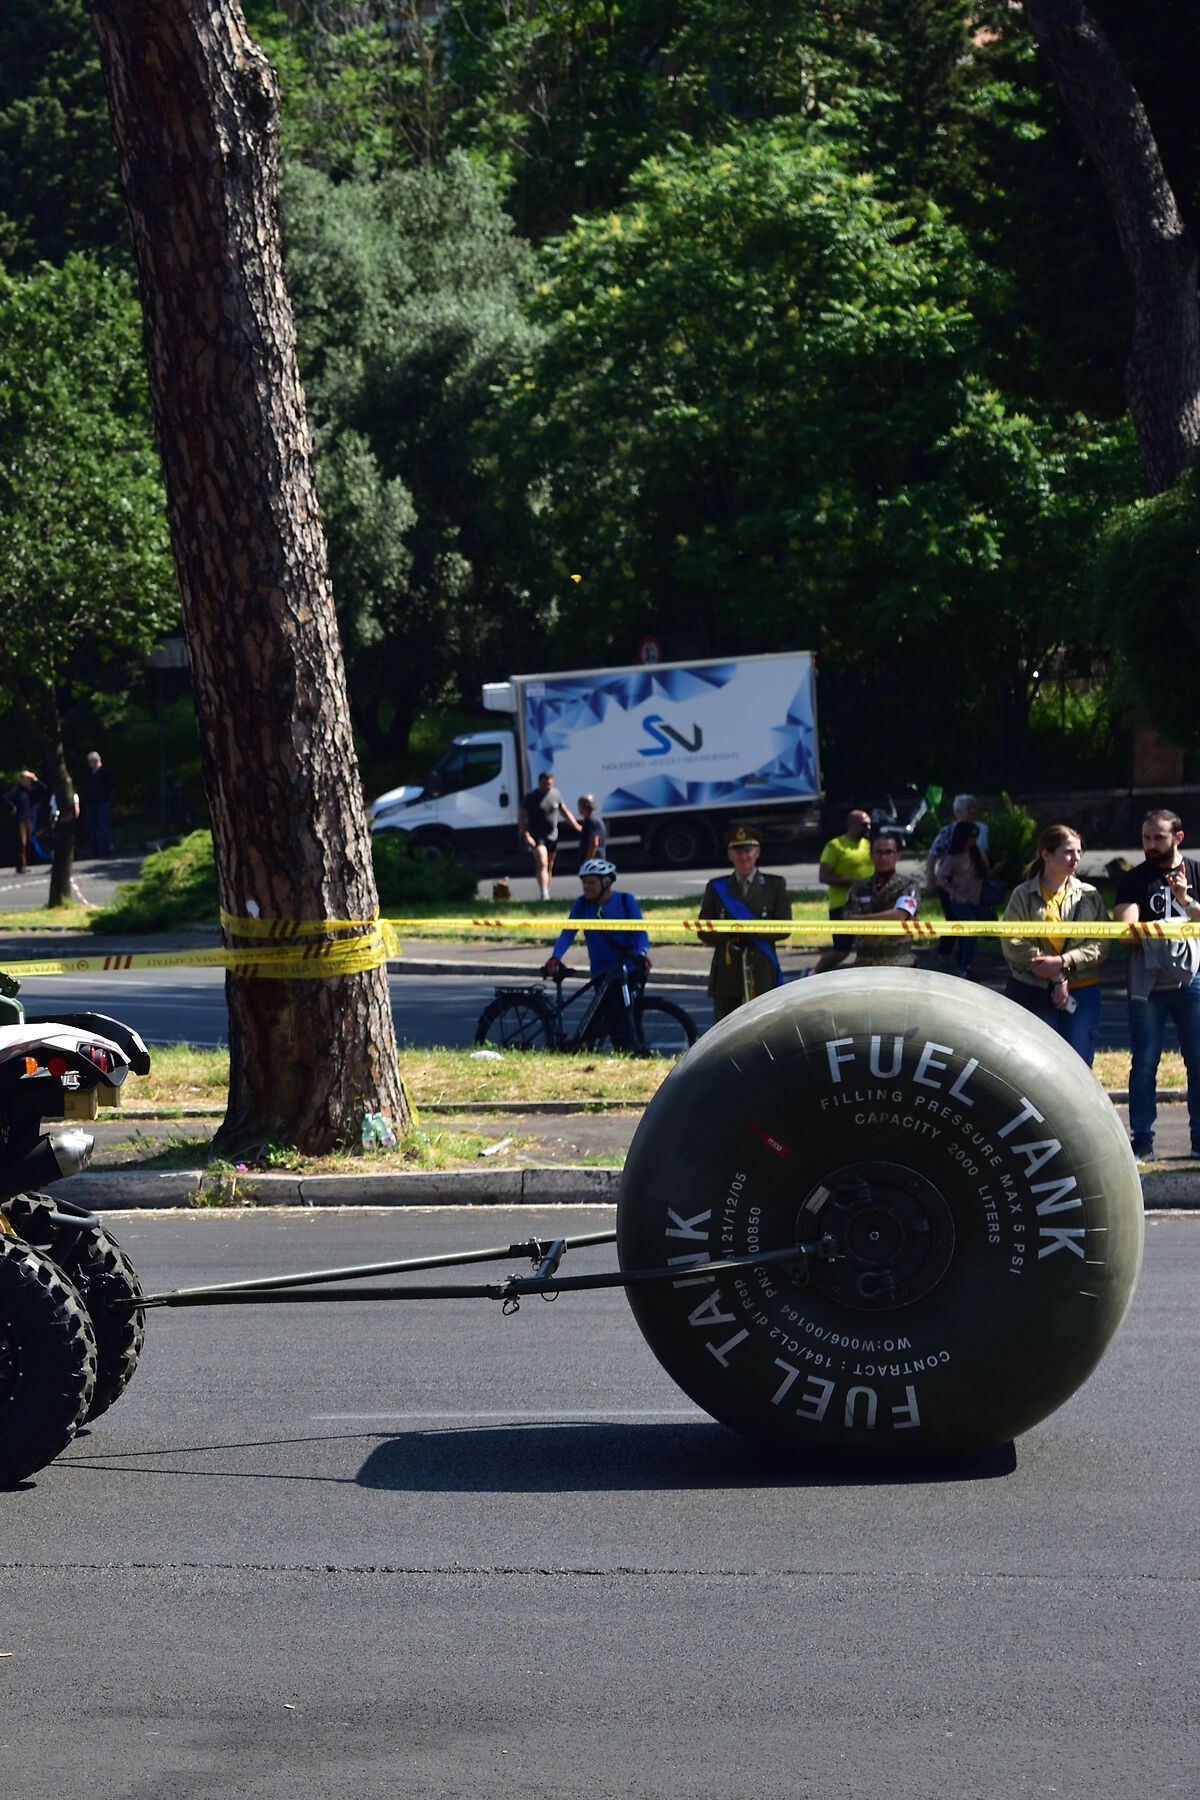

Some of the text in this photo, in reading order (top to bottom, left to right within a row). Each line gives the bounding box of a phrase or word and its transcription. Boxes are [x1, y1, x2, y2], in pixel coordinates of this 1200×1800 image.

[826, 1035, 1086, 1260] FUEL TANK
[721, 1172, 747, 1242] 21/12/05
[820, 1089, 1026, 1275] FILLING PRESSURE MAX 5 PSI
[854, 1112, 1001, 1244] CAPACITY 2000 LITERS
[665, 1206, 922, 1430] FUEL TANK
[733, 1277, 756, 1309] Rep
[752, 1309, 768, 1328] di
[768, 1326, 833, 1368] 164/CL2
[779, 1303, 912, 1353] WO:W006/00164
[851, 1350, 951, 1377] CONTRACT
